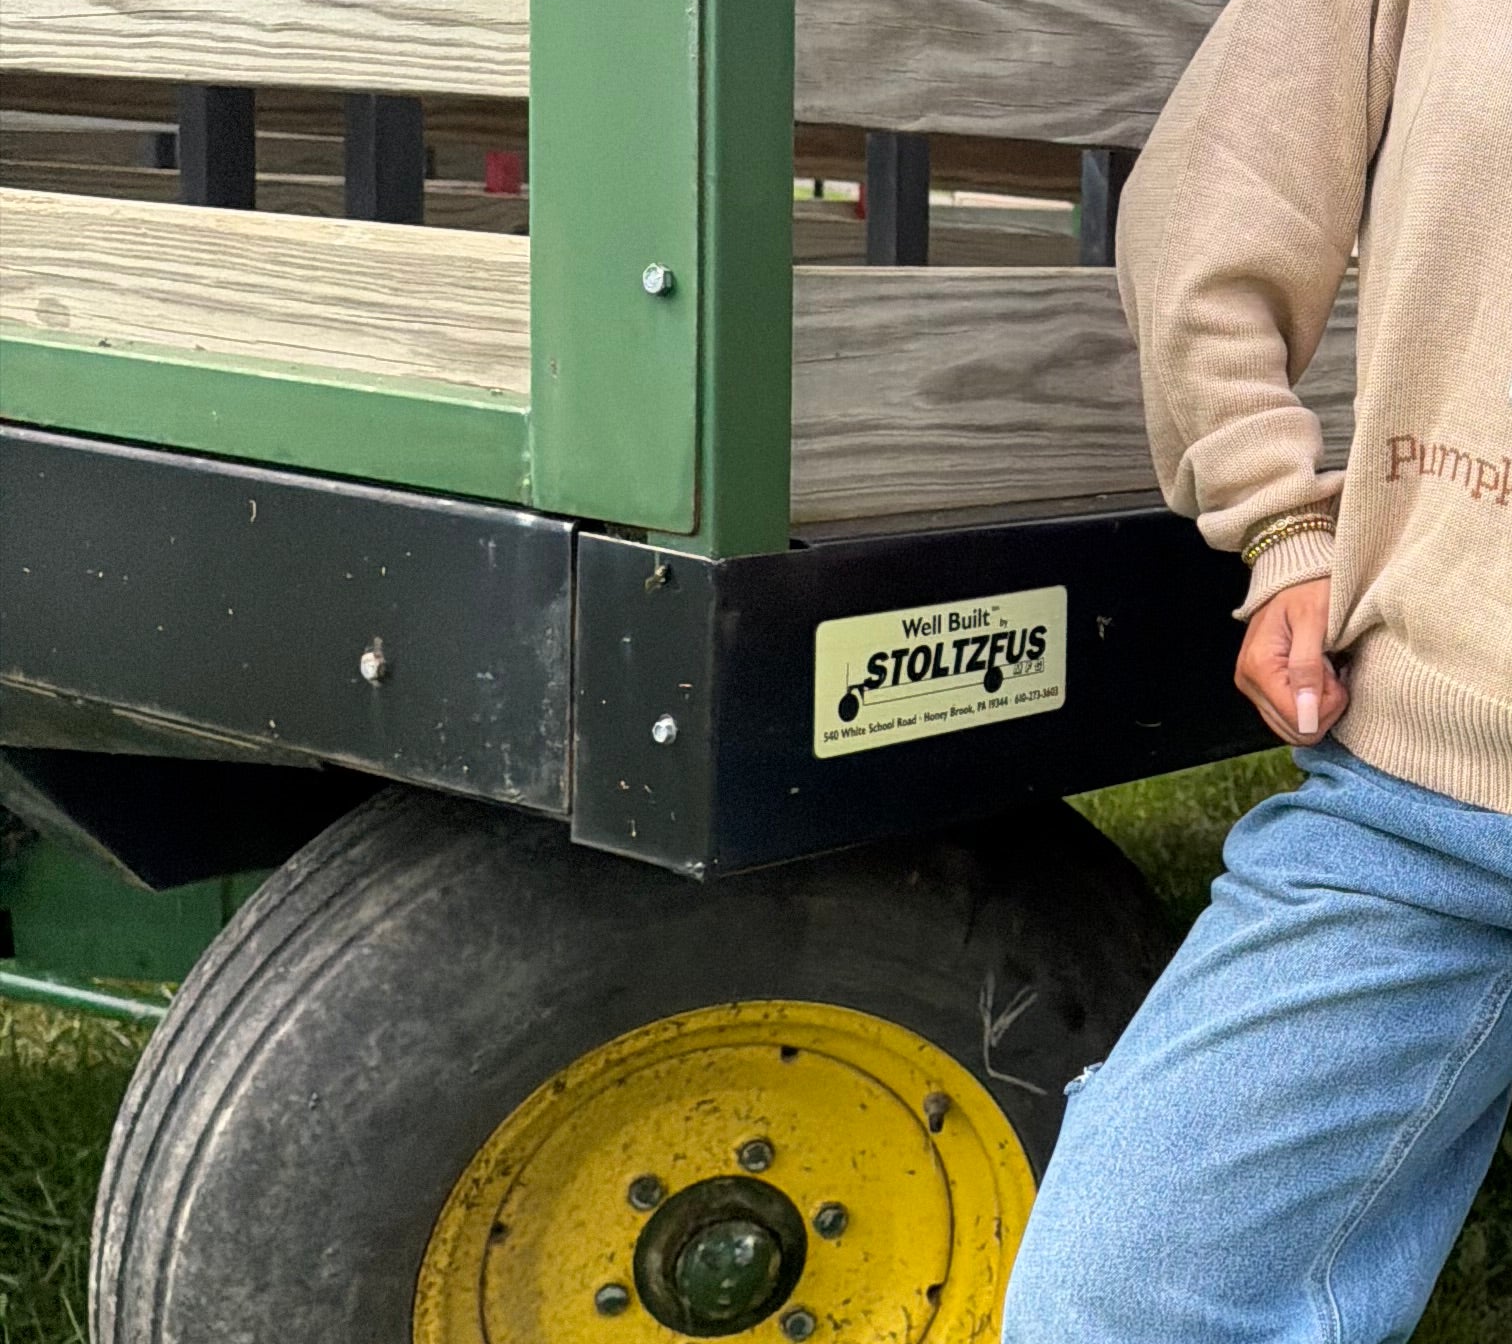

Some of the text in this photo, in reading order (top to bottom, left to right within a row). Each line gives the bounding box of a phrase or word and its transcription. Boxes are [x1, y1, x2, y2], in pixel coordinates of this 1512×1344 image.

[902, 608, 990, 639] Well Built
[1000, 618, 1008, 629] by
[867, 625, 1047, 690] STOLTZFUS
[823, 730, 839, 743] 540
[841, 726, 866, 739] White
[868, 719, 895, 734] School
[897, 714, 917, 728] Road
[924, 711, 948, 724] Honey
[950, 704, 975, 717] Brook,
[977, 700, 987, 713] PA
